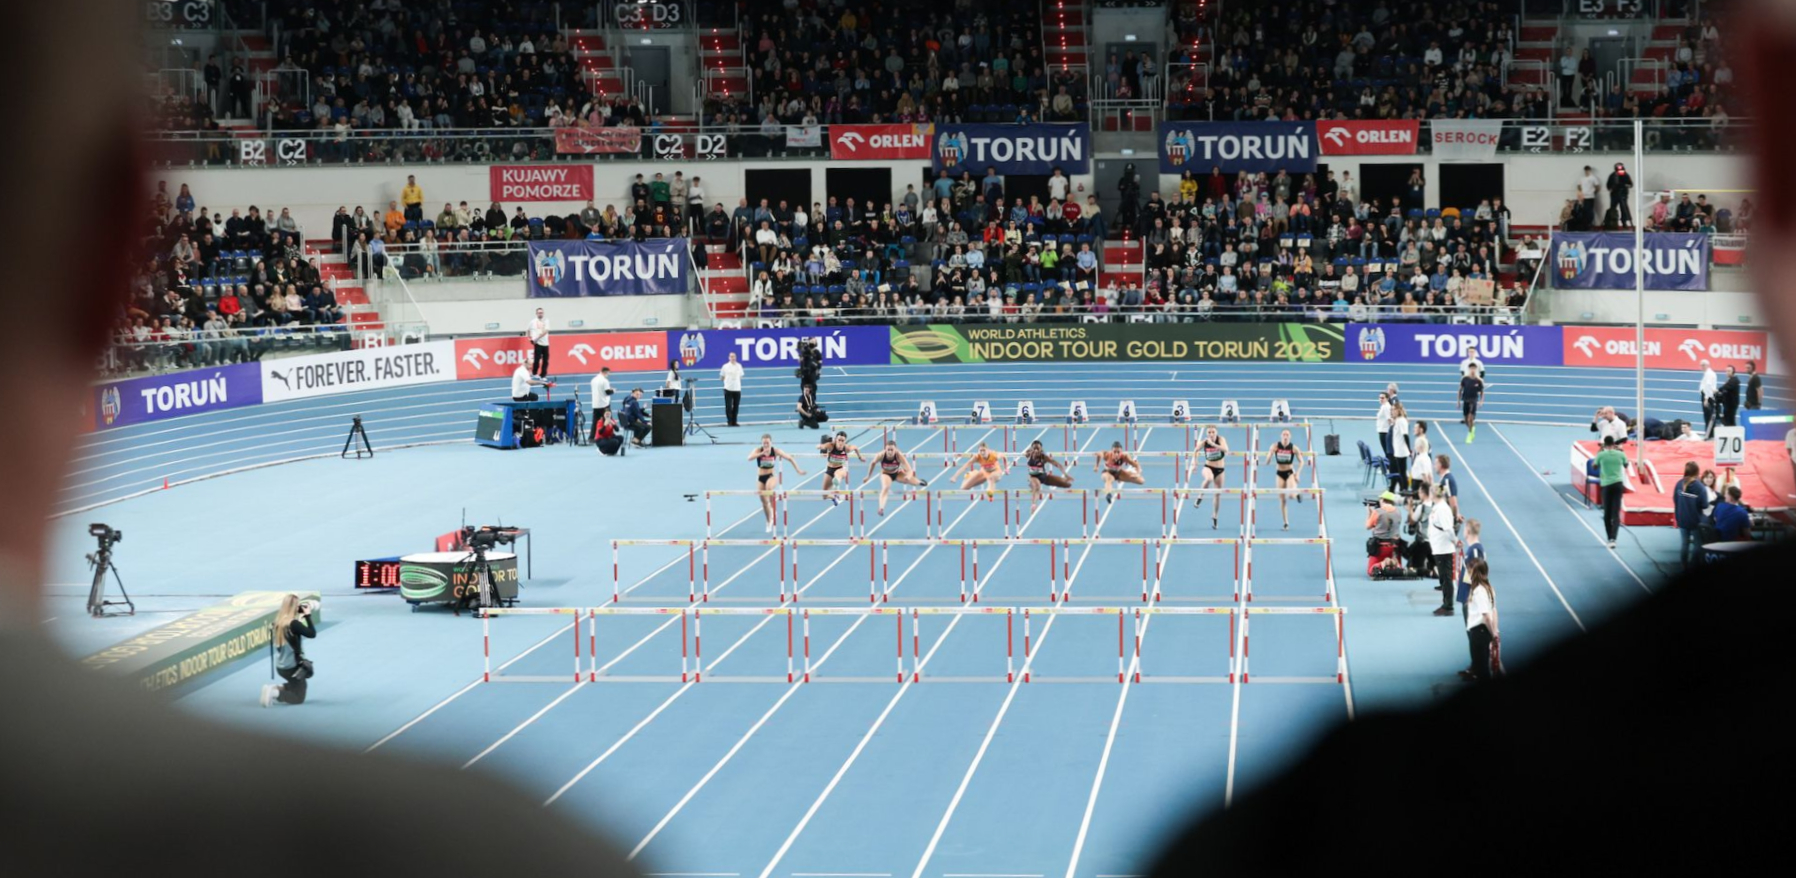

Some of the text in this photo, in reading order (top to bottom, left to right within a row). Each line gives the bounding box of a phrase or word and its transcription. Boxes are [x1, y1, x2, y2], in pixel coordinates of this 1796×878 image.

[184, 2, 210, 21] C3
[615, 4, 680, 22] C3 D3
[655, 134, 726, 155] C2 D2
[869, 134, 925, 148] ORLEN
[970, 129, 1082, 162] TORUŃ
[1198, 126, 1309, 160] TORUŃ
[1356, 129, 1411, 144] ORLEN
[1435, 131, 1499, 145] SEROCK
[1522, 126, 1591, 147] E2 F2
[241, 139, 305, 160] B2 C2
[503, 169, 568, 183] KUJAWY
[503, 184, 581, 198] POMORZE
[567, 244, 680, 281] TORUŃ
[1588, 239, 1700, 275] TORUŃ
[969, 329, 1015, 340] WORLD
[1414, 329, 1524, 359] TORUŃ
[493, 350, 535, 365] ORLE
[601, 344, 659, 361] ORLEN
[969, 337, 1331, 359] INDOOR TOUR GOLD TORUŃ 2025
[1708, 343, 1761, 360] ORLEN
[296, 352, 441, 391] FOREVER. FASTER.
[141, 372, 228, 414] TORUŃ
[1177, 405, 1184, 416] 3
[1719, 437, 1742, 454] 70
[226, 635, 246, 659] GOLD
